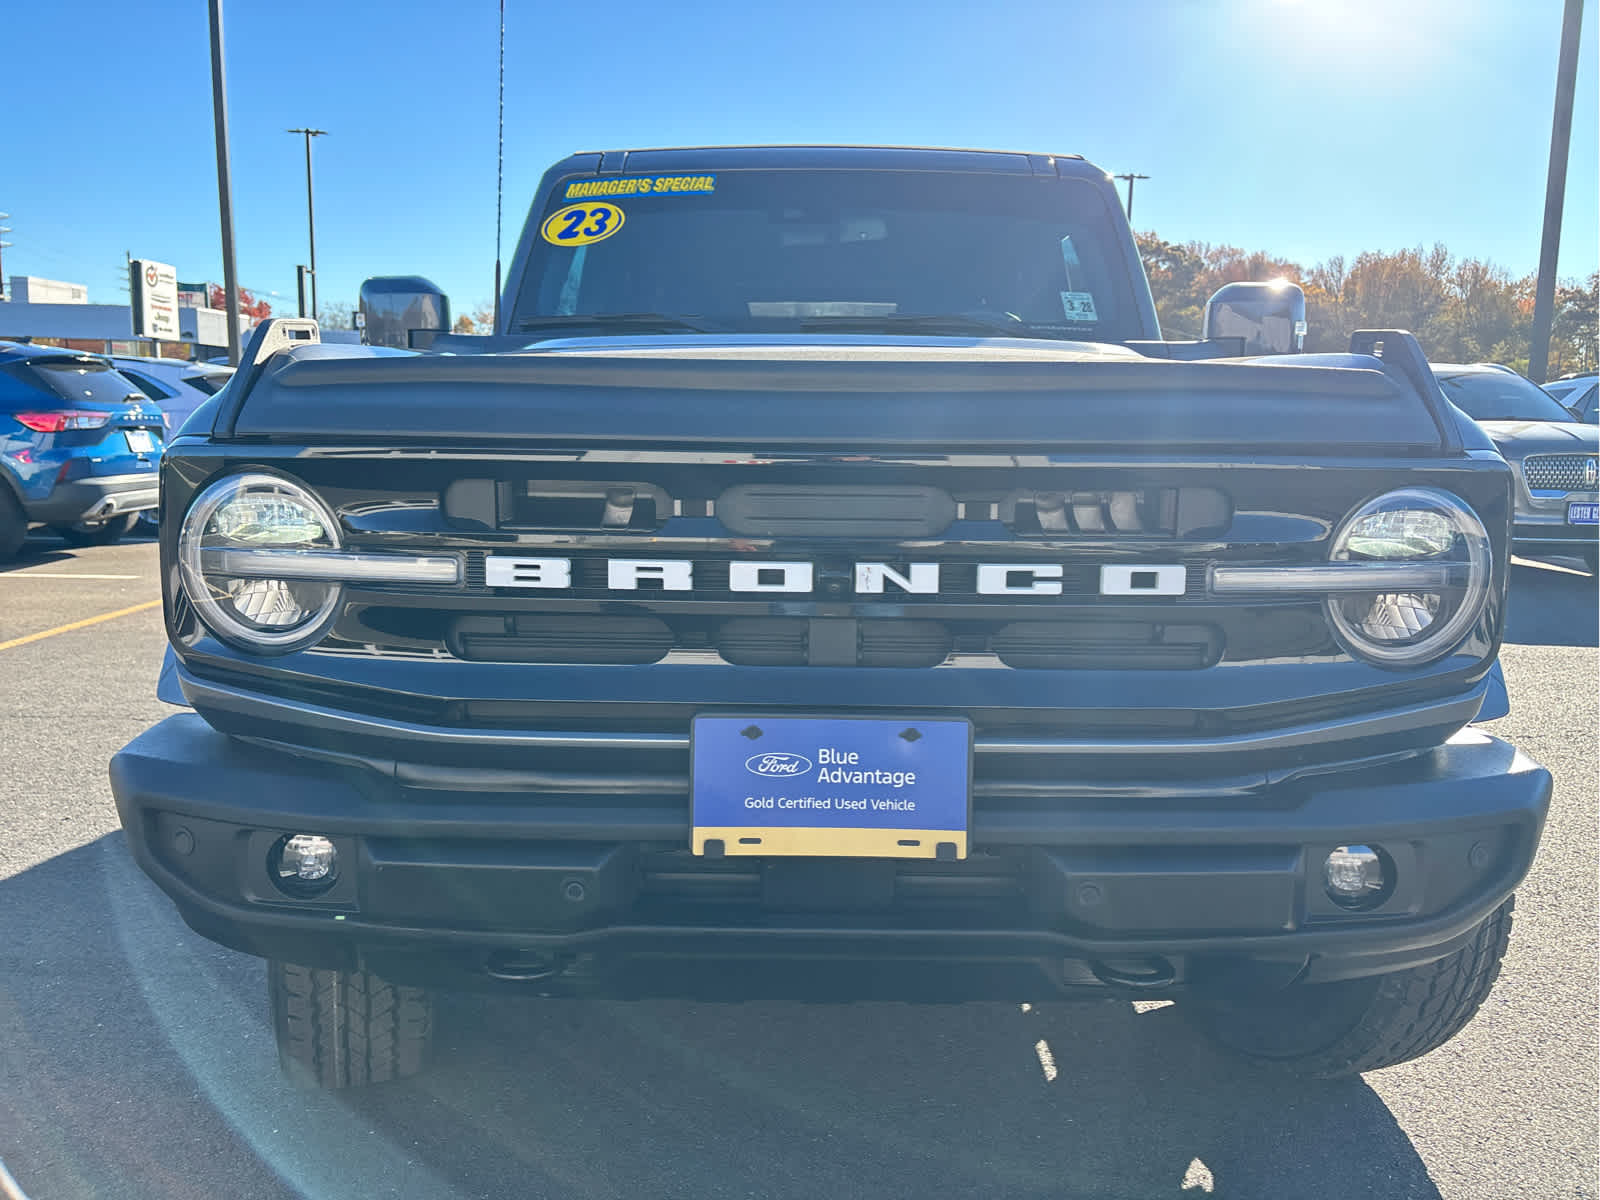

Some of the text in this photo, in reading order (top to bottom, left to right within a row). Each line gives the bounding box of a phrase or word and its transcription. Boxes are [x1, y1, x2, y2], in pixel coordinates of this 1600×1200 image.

[566, 176, 714, 198] MANAGER'S SPECIAL
[557, 207, 612, 240] 23
[485, 555, 1187, 596] BRONCO
[758, 755, 800, 773] Ford
[818, 748, 859, 765] Blue
[817, 767, 916, 788] Advantage
[744, 797, 916, 811] Gold Certified Used Vehicle
